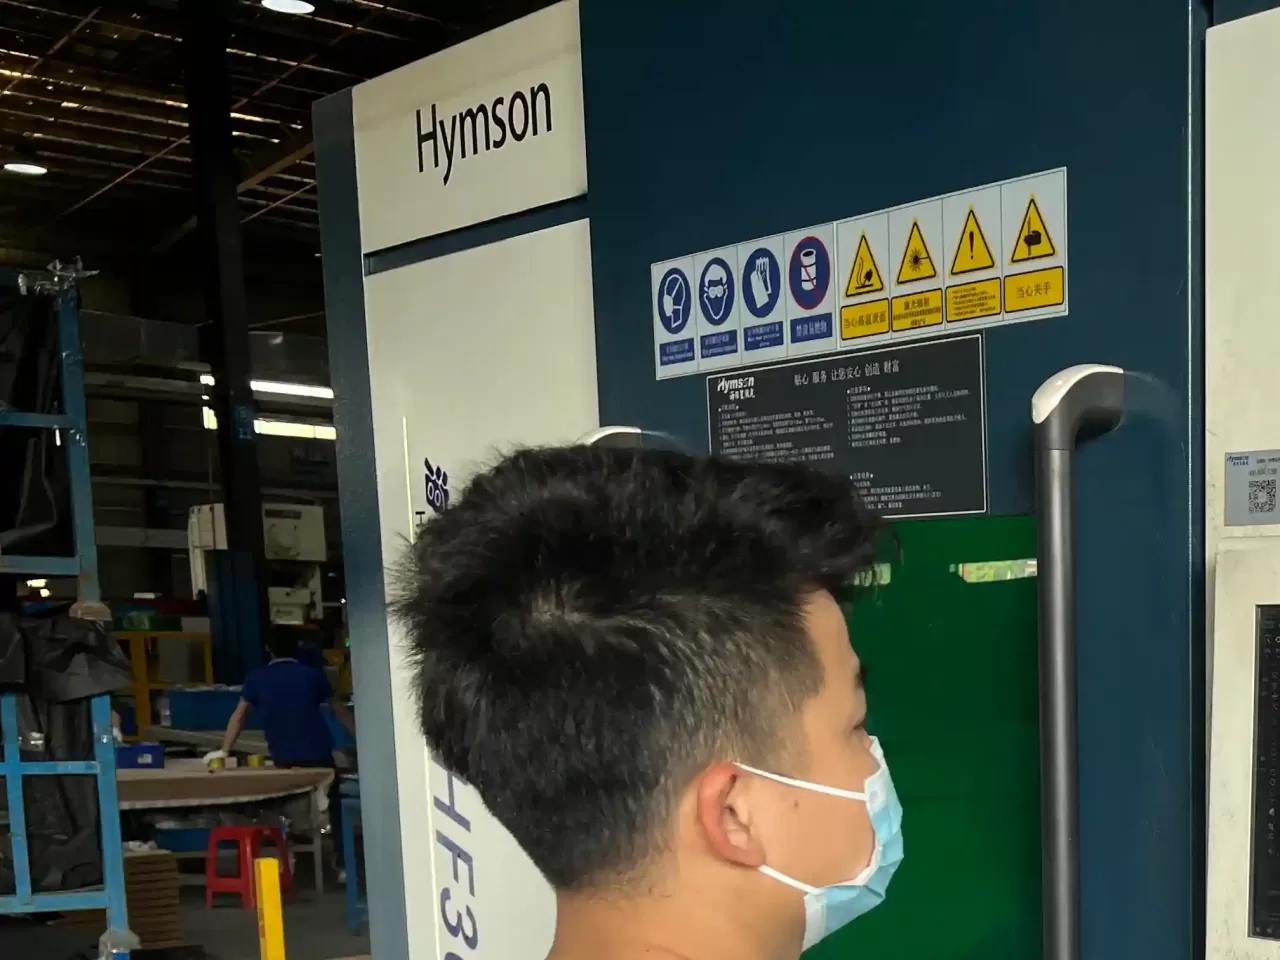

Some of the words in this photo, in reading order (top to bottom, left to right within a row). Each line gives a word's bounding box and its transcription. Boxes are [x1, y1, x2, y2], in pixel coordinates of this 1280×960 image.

[416, 83, 552, 186] Hymson
[1016, 281, 1052, 299] 当心夹手
[794, 373, 809, 386] 贴心
[812, 370, 827, 384] 服务
[831, 365, 862, 381] 让您安心
[864, 362, 880, 376] 创造
[883, 359, 900, 373] 财富
[717, 376, 755, 393] Hymson
